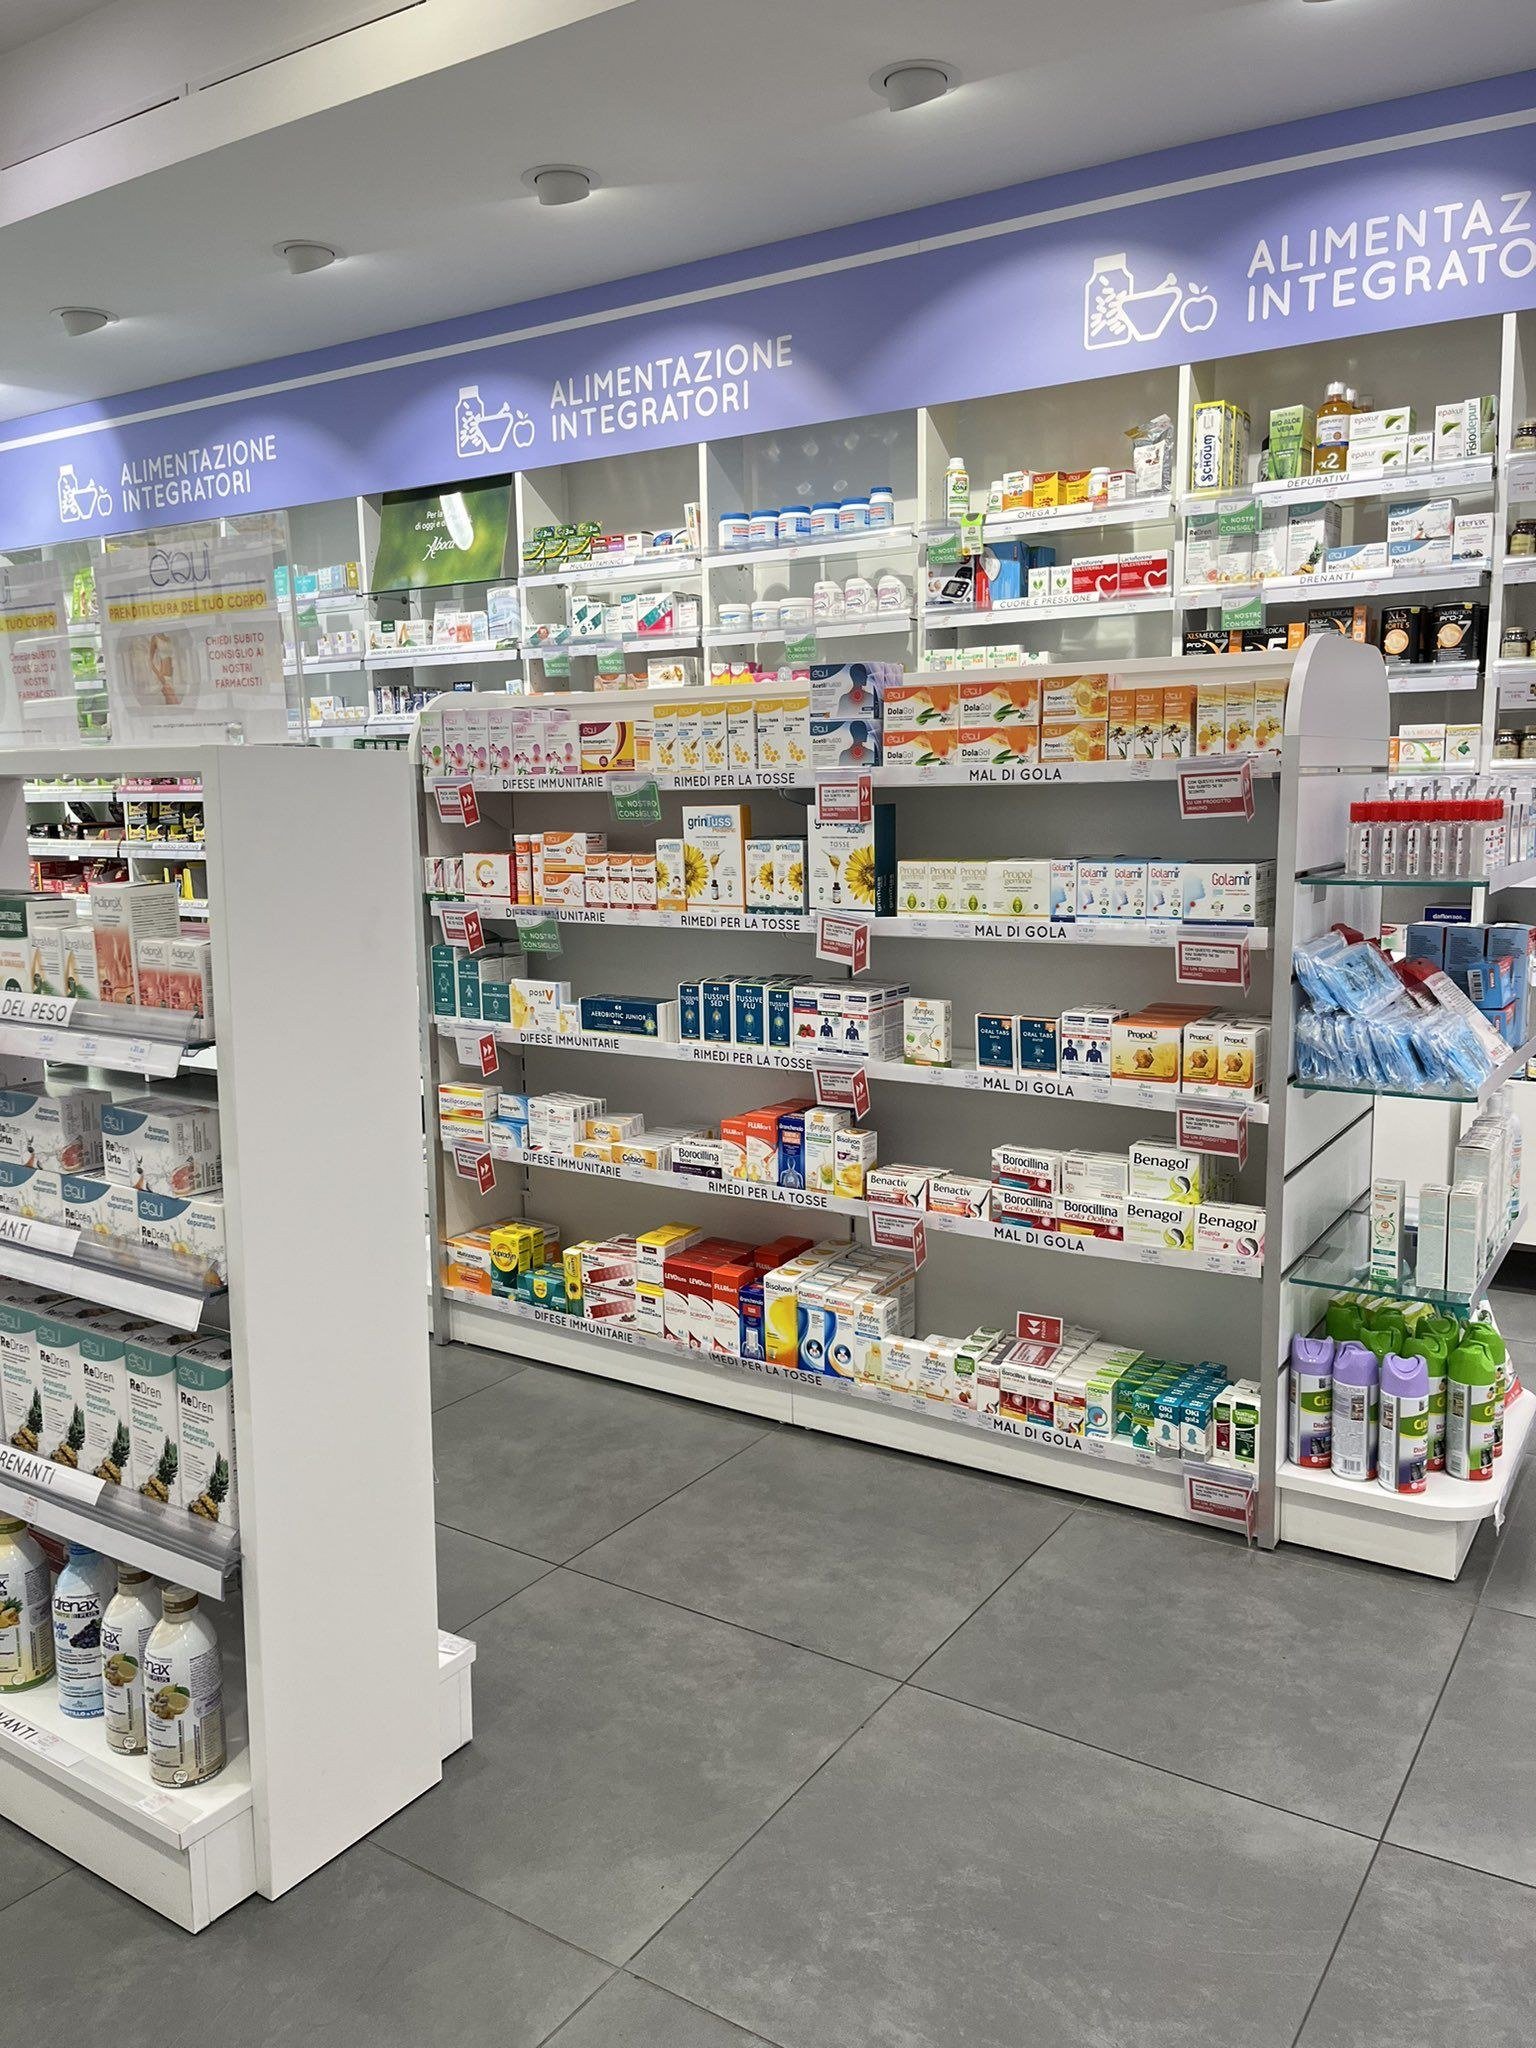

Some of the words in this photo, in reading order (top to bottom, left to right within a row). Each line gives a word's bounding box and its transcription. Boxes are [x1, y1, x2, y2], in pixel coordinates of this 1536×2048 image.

[1247, 190, 1532, 278] ALIMENTAZ
[1248, 238, 1536, 322] INTEGRATO
[551, 335, 793, 409] ALIMENTAZIONE
[552, 380, 749, 442] INTEGRATORI
[1467, 403, 1477, 456] Fisiodepur
[121, 434, 276, 486] ALIMENTAZIONE
[1287, 473, 1350, 488] DEPURATIVI
[122, 469, 250, 513] INTEGRATORI
[1017, 509, 1051, 519] OMEGA
[1052, 507, 1058, 515] 3
[570, 557, 624, 571] MULTIVITAMINICI
[1300, 572, 1355, 584] DRENANTI
[109, 604, 150, 621] PRENDITI
[151, 604, 179, 616] CURA
[182, 600, 200, 614] DEL
[202, 597, 223, 610] TUO
[1000, 599, 1028, 609] CUORE
[1032, 599, 1039, 607] E
[1043, 595, 1091, 606] PRESSIONE
[6, 617, 23, 630] TUO
[205, 635, 232, 646] CHIEDI
[234, 633, 264, 643] SUBITO
[208, 649, 252, 660] CONSIGLIO
[222, 664, 253, 674] NOSTRI
[215, 677, 262, 688] FARMACISTI
[674, 775, 710, 787] RIMEDI
[715, 775, 734, 786] PER
[738, 774, 752, 785] LA
[756, 773, 795, 784] TOSSE
[969, 769, 996, 781] MAL
[1002, 769, 1015, 780] DI
[1020, 768, 1062, 780] GOLA
[502, 777, 536, 790] DIFESE
[538, 776, 603, 789] IMMUNITARIE
[688, 815, 732, 833] grinTuss
[930, 867, 957, 876] Propol
[1002, 869, 1033, 880] Propol
[1080, 867, 1108, 878] Golamir
[1115, 867, 1143, 878] Golamir
[1151, 867, 1180, 878] Golamir
[1212, 871, 1252, 886] Golamir
[541, 909, 605, 923] IMMUNITARIE
[680, 915, 717, 927] RIMEDI
[720, 917, 740, 928] PER
[744, 919, 759, 928] LA
[762, 920, 801, 930] TOSSE
[975, 926, 1002, 937] MAL
[1007, 926, 1020, 937] DI
[1025, 926, 1066, 938] GOLA
[704, 993, 730, 1001] TUSSIVE
[737, 995, 763, 1004] TUSSIVE
[2, 998, 26, 1017] DEL
[30, 1002, 68, 1022] PESO
[743, 1002, 756, 1010] FLU
[591, 1010, 624, 1019] AEROBIOTIC
[625, 1013, 646, 1021] JUNIOR
[520, 1032, 552, 1044] DIFESE
[555, 1035, 619, 1049] IMMUNITARIE
[693, 1049, 730, 1061] RIMEDI
[733, 1053, 753, 1064] PER
[756, 1055, 770, 1066] LA
[774, 1057, 813, 1070] TOSSE
[983, 1077, 1010, 1090] MAL
[1015, 1080, 1027, 1091] DI
[1033, 1083, 1074, 1097] GOLA
[836, 1136, 861, 1144] Bisolvon
[679, 1148, 719, 1161] Borocillina
[1134, 1153, 1189, 1171] Benagol
[522, 1152, 554, 1166] DIFESE
[557, 1158, 621, 1177] IMMUNITARIE
[1002, 1154, 1049, 1171] Borocillina
[871, 1175, 908, 1188] Benactiv
[708, 1182, 744, 1196] RIMEDI
[748, 1187, 768, 1199] PER
[771, 1190, 785, 1202] LA
[789, 1193, 827, 1208] TOSSE
[933, 1183, 972, 1196] Benactiv
[1004, 1193, 1053, 1209] Borocillina
[1064, 1199, 1118, 1218] Borocillina
[1127, 1204, 1182, 1223] Benagol
[1199, 1213, 1256, 1232] Benagol
[994, 1227, 1021, 1242] MAL
[1026, 1232, 1038, 1244] DI
[1043, 1235, 1085, 1252] GOLA
[765, 1281, 793, 1292] Bisolvon
[534, 1310, 567, 1326] DIFESE
[569, 1319, 633, 1343] IMMUNITARIE
[0, 1335, 30, 1355] ReDren
[39, 1350, 70, 1369] ReDren
[83, 1363, 114, 1383] ReDren
[741, 1359, 762, 1372] PER
[765, 1363, 779, 1375] LA
[783, 1367, 823, 1386] TOSSE
[129, 1378, 162, 1399] ReDren
[180, 1391, 213, 1415] ReDren
[993, 1419, 1021, 1435] MAL
[1025, 1427, 1037, 1438] DI
[1041, 1431, 1082, 1451] GOLA
